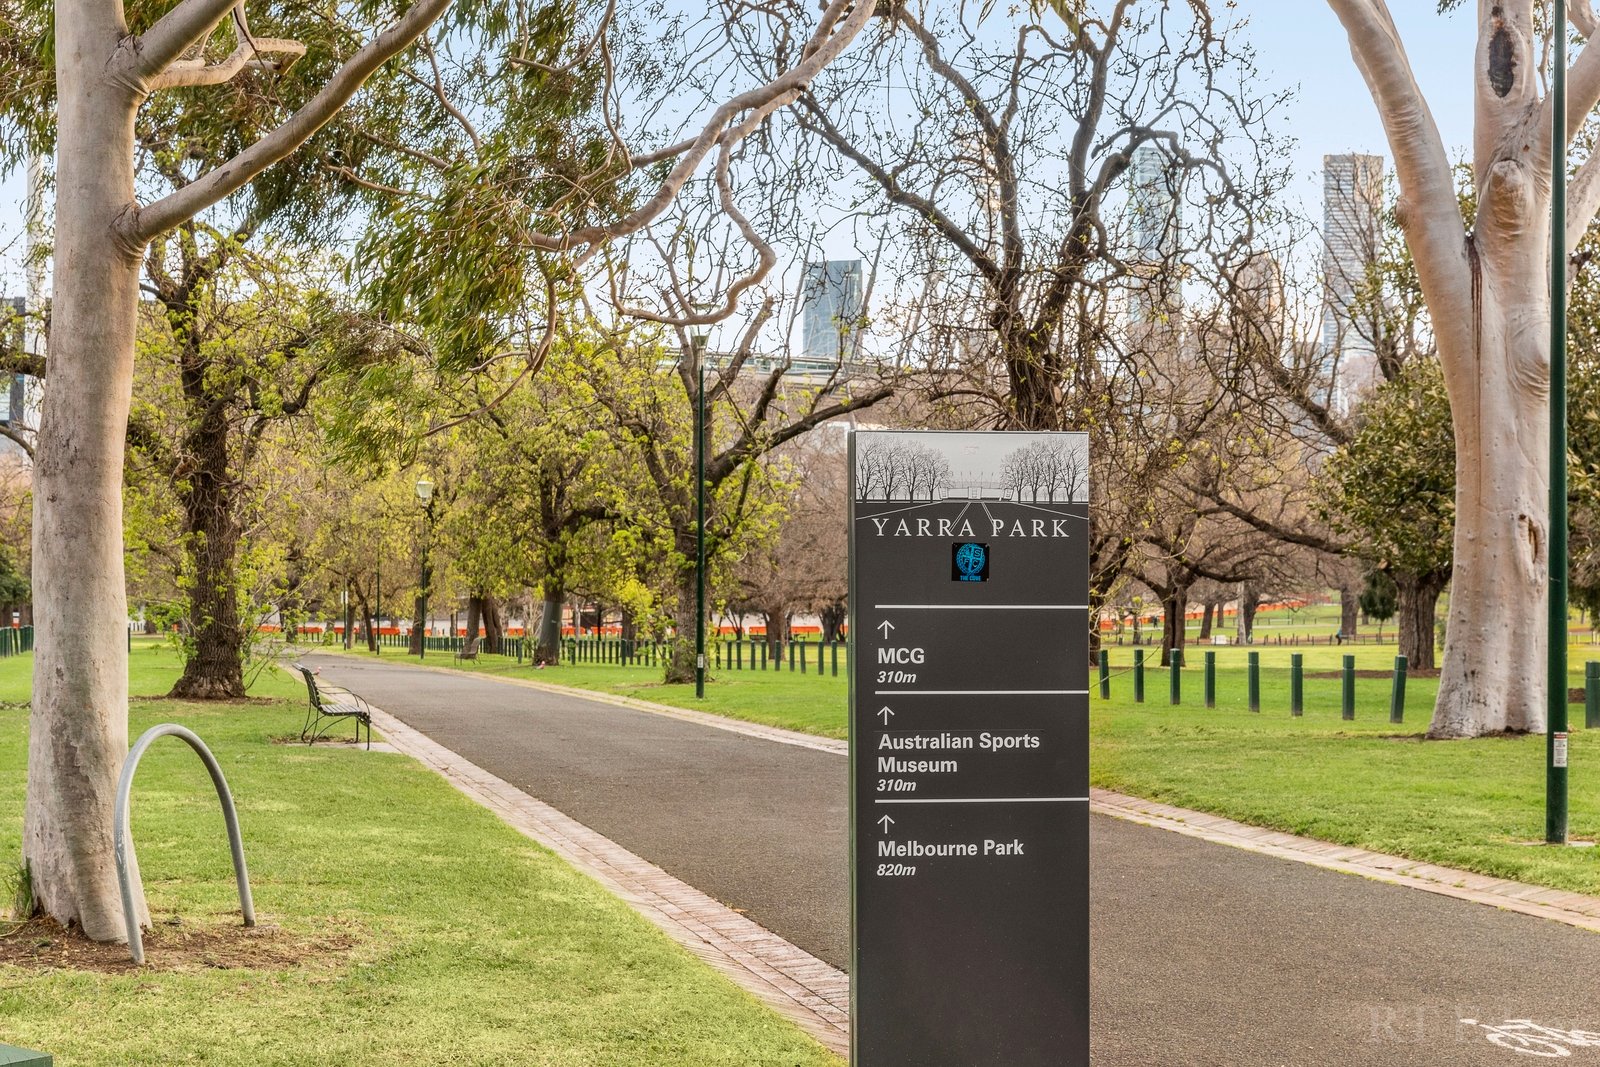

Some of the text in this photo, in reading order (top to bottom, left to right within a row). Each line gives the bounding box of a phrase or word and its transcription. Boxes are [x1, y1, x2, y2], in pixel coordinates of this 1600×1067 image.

[872, 518, 1069, 537] YARRA PARK
[878, 648, 924, 664] MCG
[877, 671, 916, 683] 310m
[879, 733, 1039, 752] Australian Sports
[878, 757, 957, 772] Museum
[877, 779, 916, 791] 310m
[879, 839, 1024, 856] Melbourne Park
[877, 864, 916, 876] 820m
